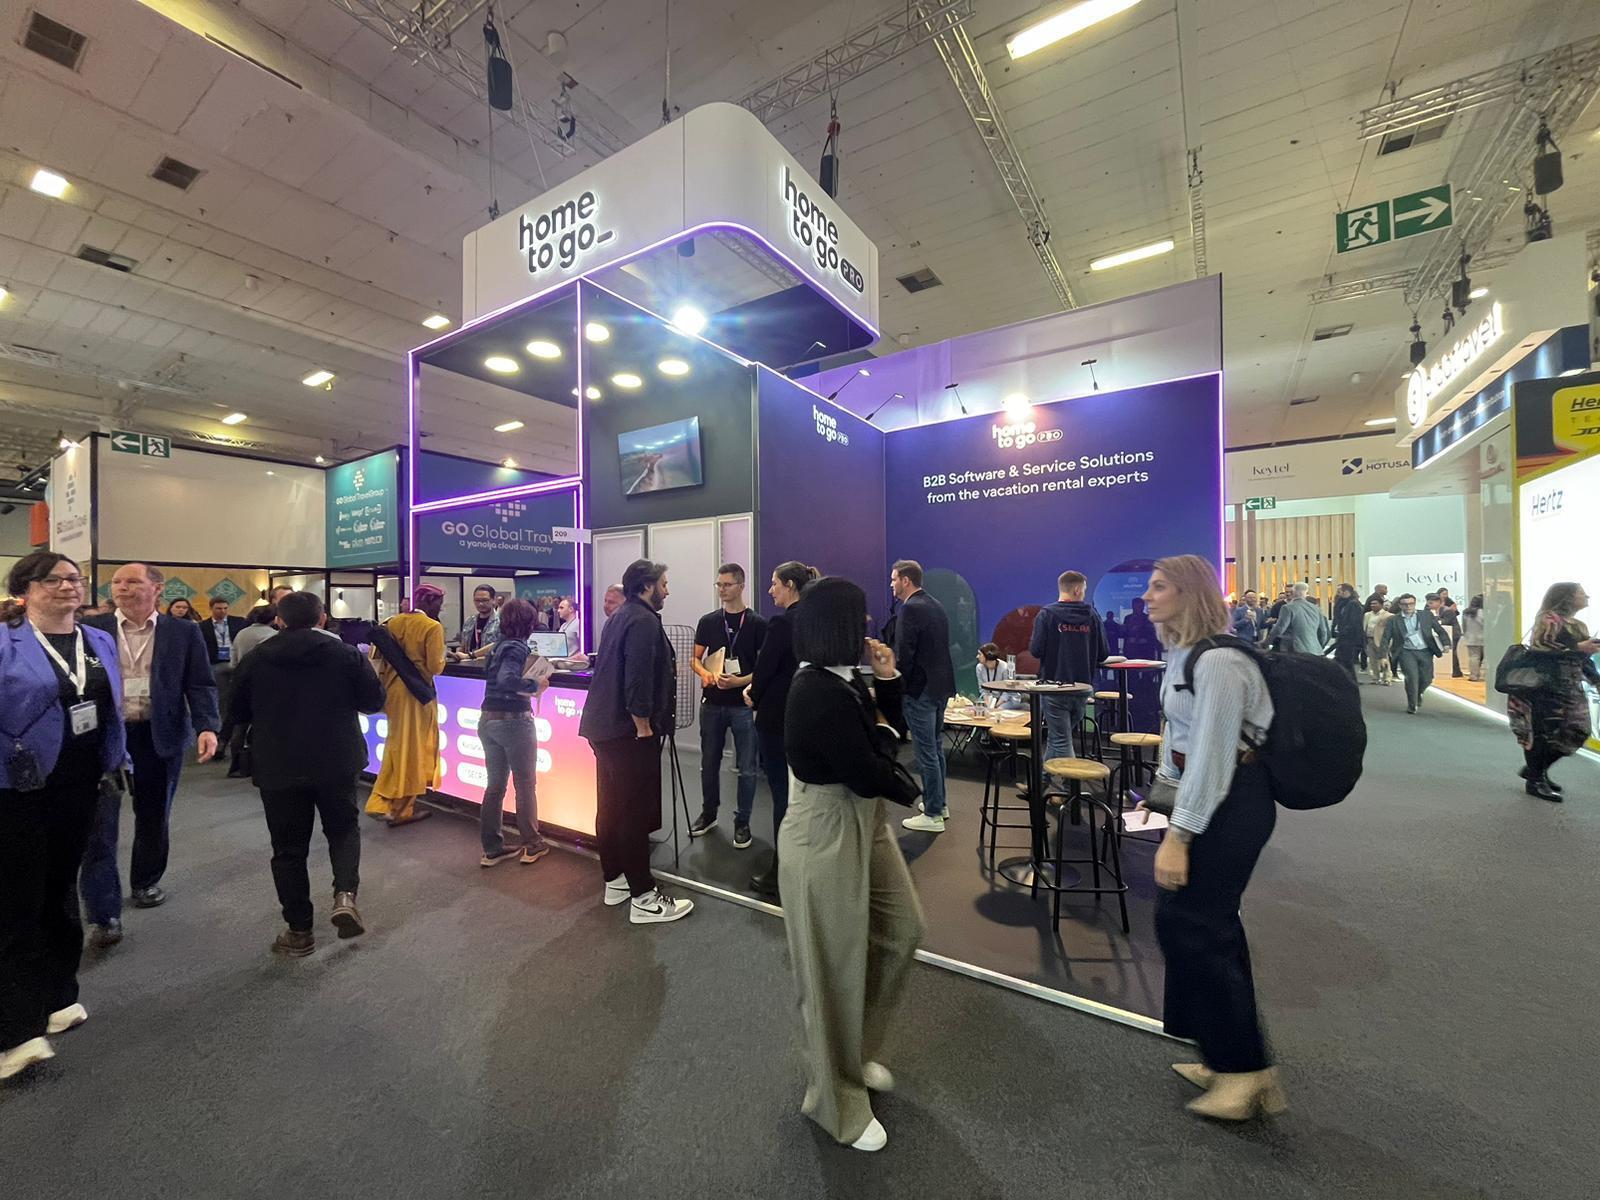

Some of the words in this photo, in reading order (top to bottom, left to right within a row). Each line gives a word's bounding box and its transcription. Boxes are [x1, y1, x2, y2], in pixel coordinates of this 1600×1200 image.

[785, 166, 838, 245] home
[520, 191, 594, 250] home
[794, 209, 812, 246] to
[817, 236, 838, 269] go
[528, 243, 553, 273] to
[813, 404, 837, 428] home
[1571, 398, 1600, 409] He
[923, 474, 946, 487] B2B
[949, 468, 1005, 484] Software
[1009, 465, 1019, 478] &
[1023, 460, 1076, 476] Service
[1080, 451, 1154, 469] Solutions
[1366, 460, 1410, 471] HOTUSA
[927, 492, 955, 504] from
[959, 489, 979, 501] the
[982, 482, 1039, 498] vacation
[1042, 475, 1084, 491] rental
[1088, 471, 1149, 488] experts
[1532, 490, 1563, 515] Hertz
[441, 521, 469, 536] GO
[472, 524, 522, 541] Global
[467, 540, 497, 550] yanolja
[498, 541, 518, 550] cloud
[520, 544, 552, 554] company
